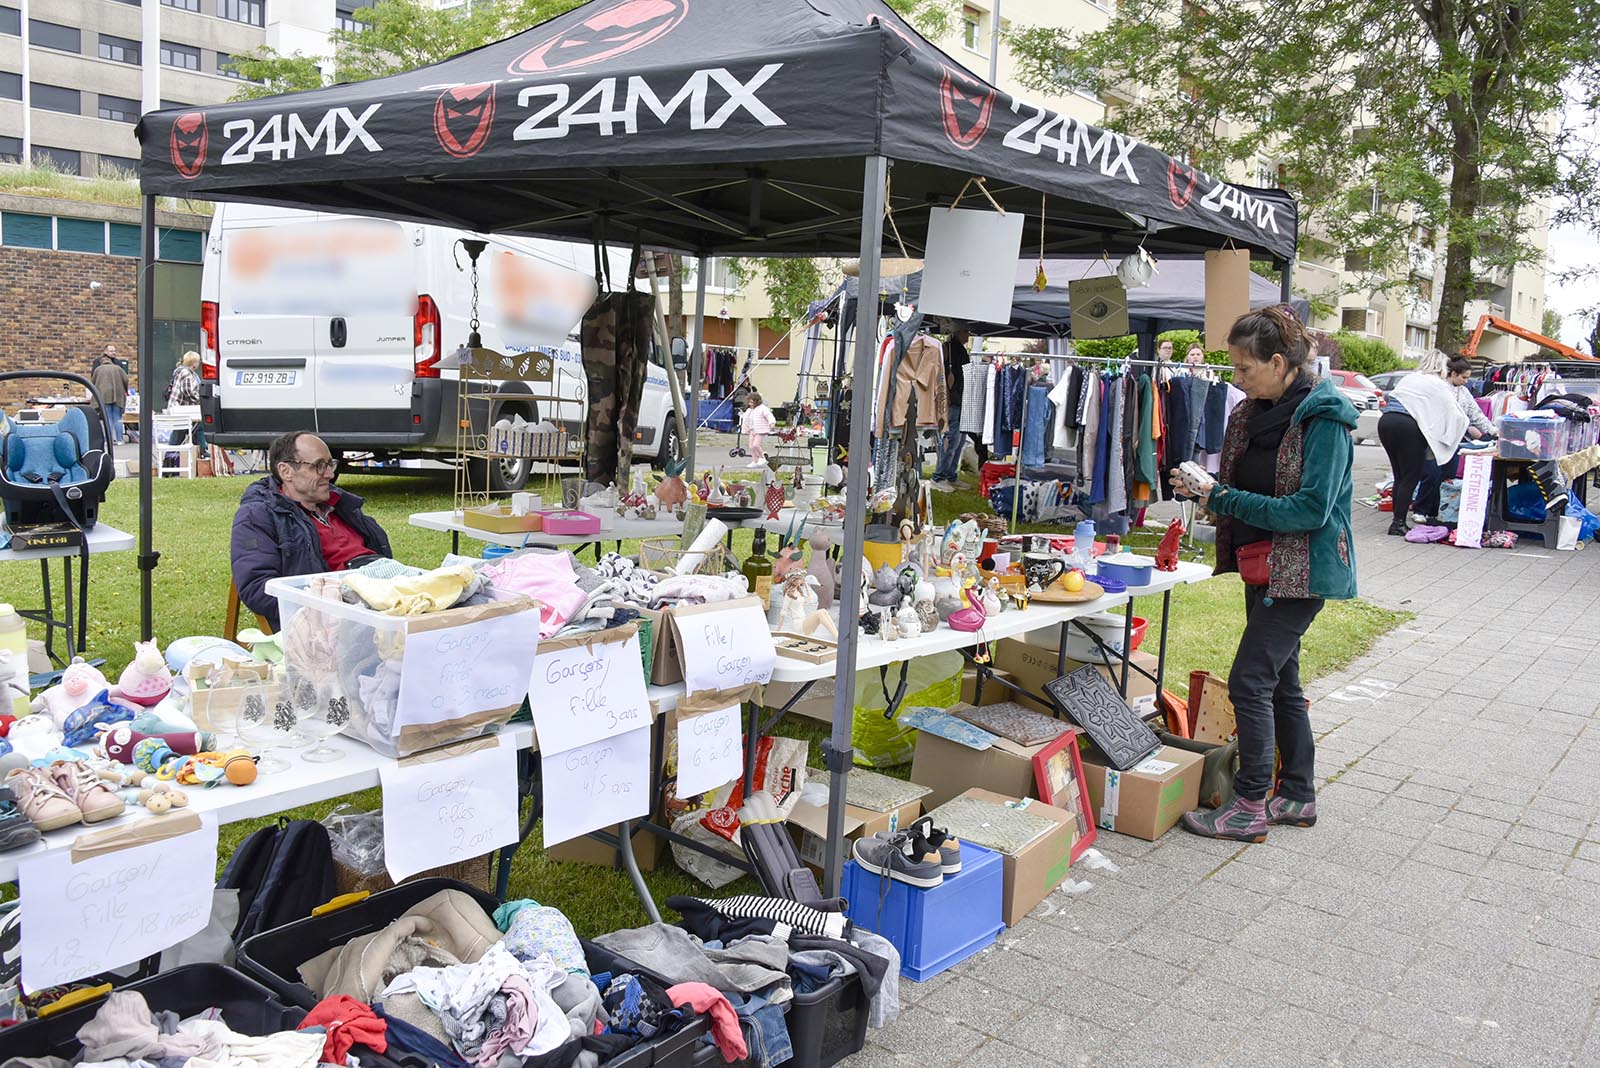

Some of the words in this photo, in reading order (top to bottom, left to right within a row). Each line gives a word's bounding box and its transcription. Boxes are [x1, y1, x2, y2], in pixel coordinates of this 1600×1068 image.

[513, 62, 787, 141] 24MX
[220, 102, 383, 165] 24MX
[1001, 96, 1140, 185] 24MX
[1199, 174, 1280, 235] 24MX
[226, 338, 263, 346] CITROËN
[560, 350, 570, 362] SUD
[607, 710, 618, 730] 3
[693, 748, 702, 767] 6
[722, 737, 733, 758] 8
[449, 827, 464, 855] 2
